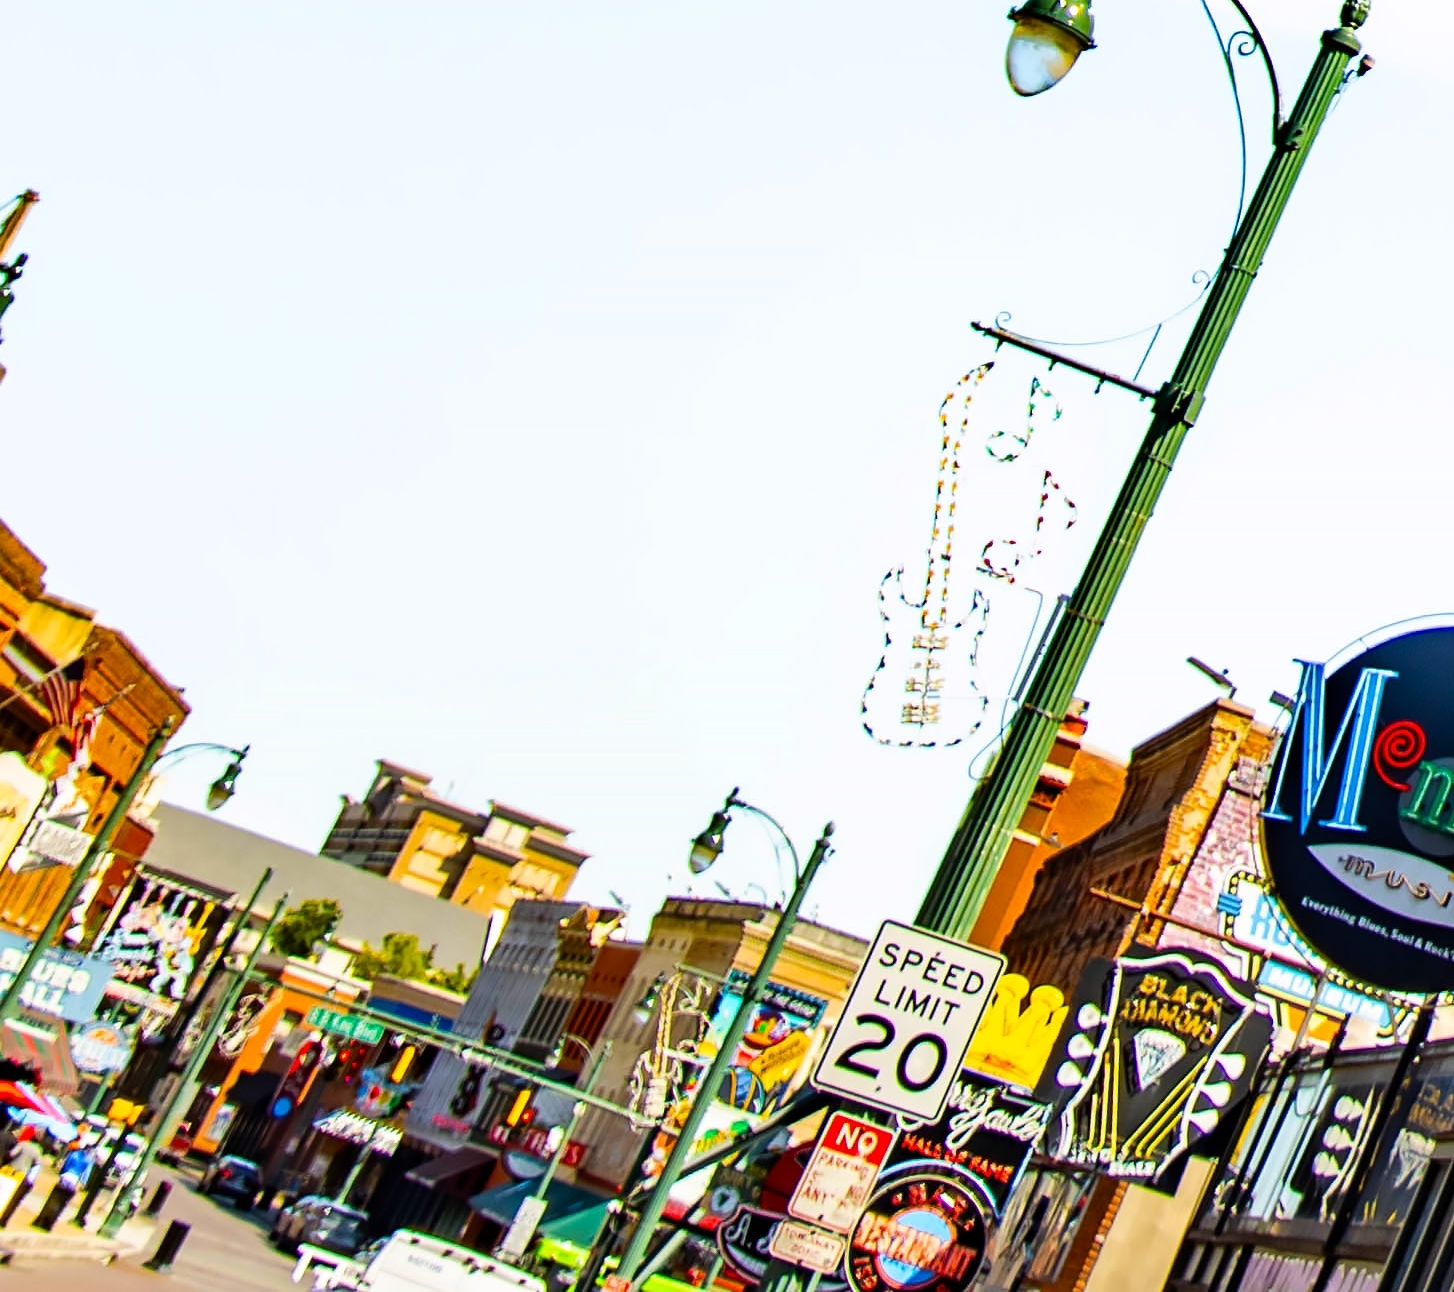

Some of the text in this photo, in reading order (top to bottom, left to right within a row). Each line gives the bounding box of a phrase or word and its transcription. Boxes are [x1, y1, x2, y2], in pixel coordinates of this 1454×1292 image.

[1300, 895, 1356, 927] Everything
[1358, 915, 1389, 939] Blues,
[1391, 928, 1415, 947] Soul
[878, 942, 985, 995] SPEED
[1138, 974, 1223, 1013] BLACK
[873, 978, 961, 1025] LIMIT
[1119, 998, 1220, 1047] DIAMOND
[834, 1012, 949, 1093] 20
[835, 1122, 878, 1157] NO
[902, 1132, 943, 1160] HALL
[968, 1155, 1014, 1184] FAME
